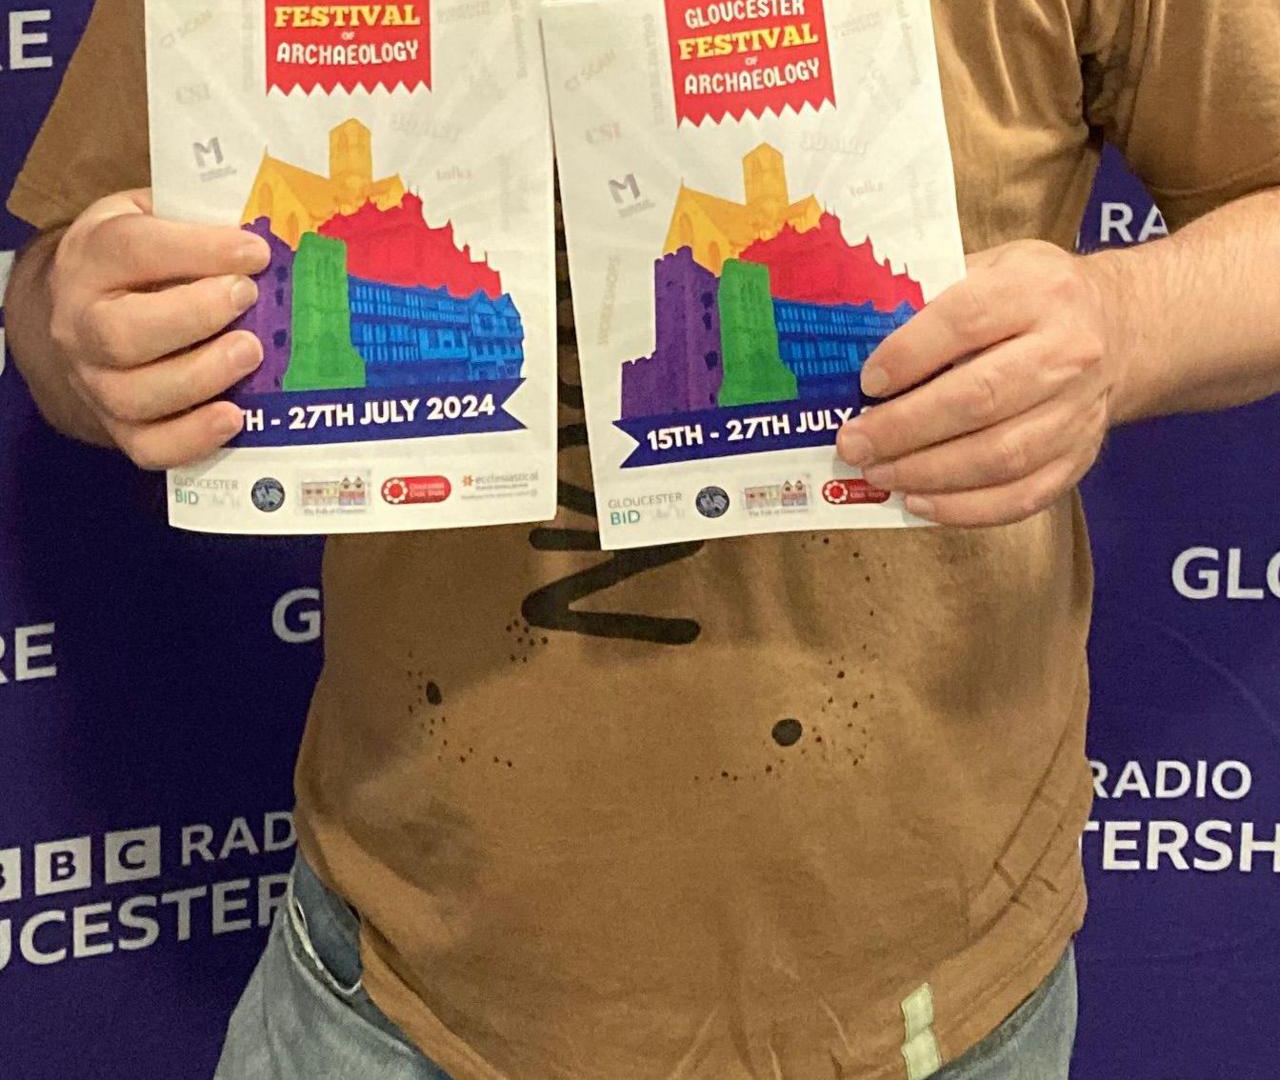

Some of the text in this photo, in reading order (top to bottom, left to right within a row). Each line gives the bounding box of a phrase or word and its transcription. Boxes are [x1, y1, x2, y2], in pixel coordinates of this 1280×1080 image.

[273, 4, 421, 28] FESTIVAL
[276, 39, 419, 66] ARCHAEOLOGY
[678, 22, 819, 61] FESTIVAL
[684, 56, 820, 95] ARCHAEOLOGY
[287, 403, 354, 430] 27TH
[360, 399, 420, 425] JULY
[426, 394, 495, 420] 2024
[647, 424, 703, 451] 15TH
[725, 414, 790, 441] 27TH
[175, 489, 199, 505] BID
[608, 492, 682, 509] GLOUCESTER
[610, 510, 641, 526] BID
